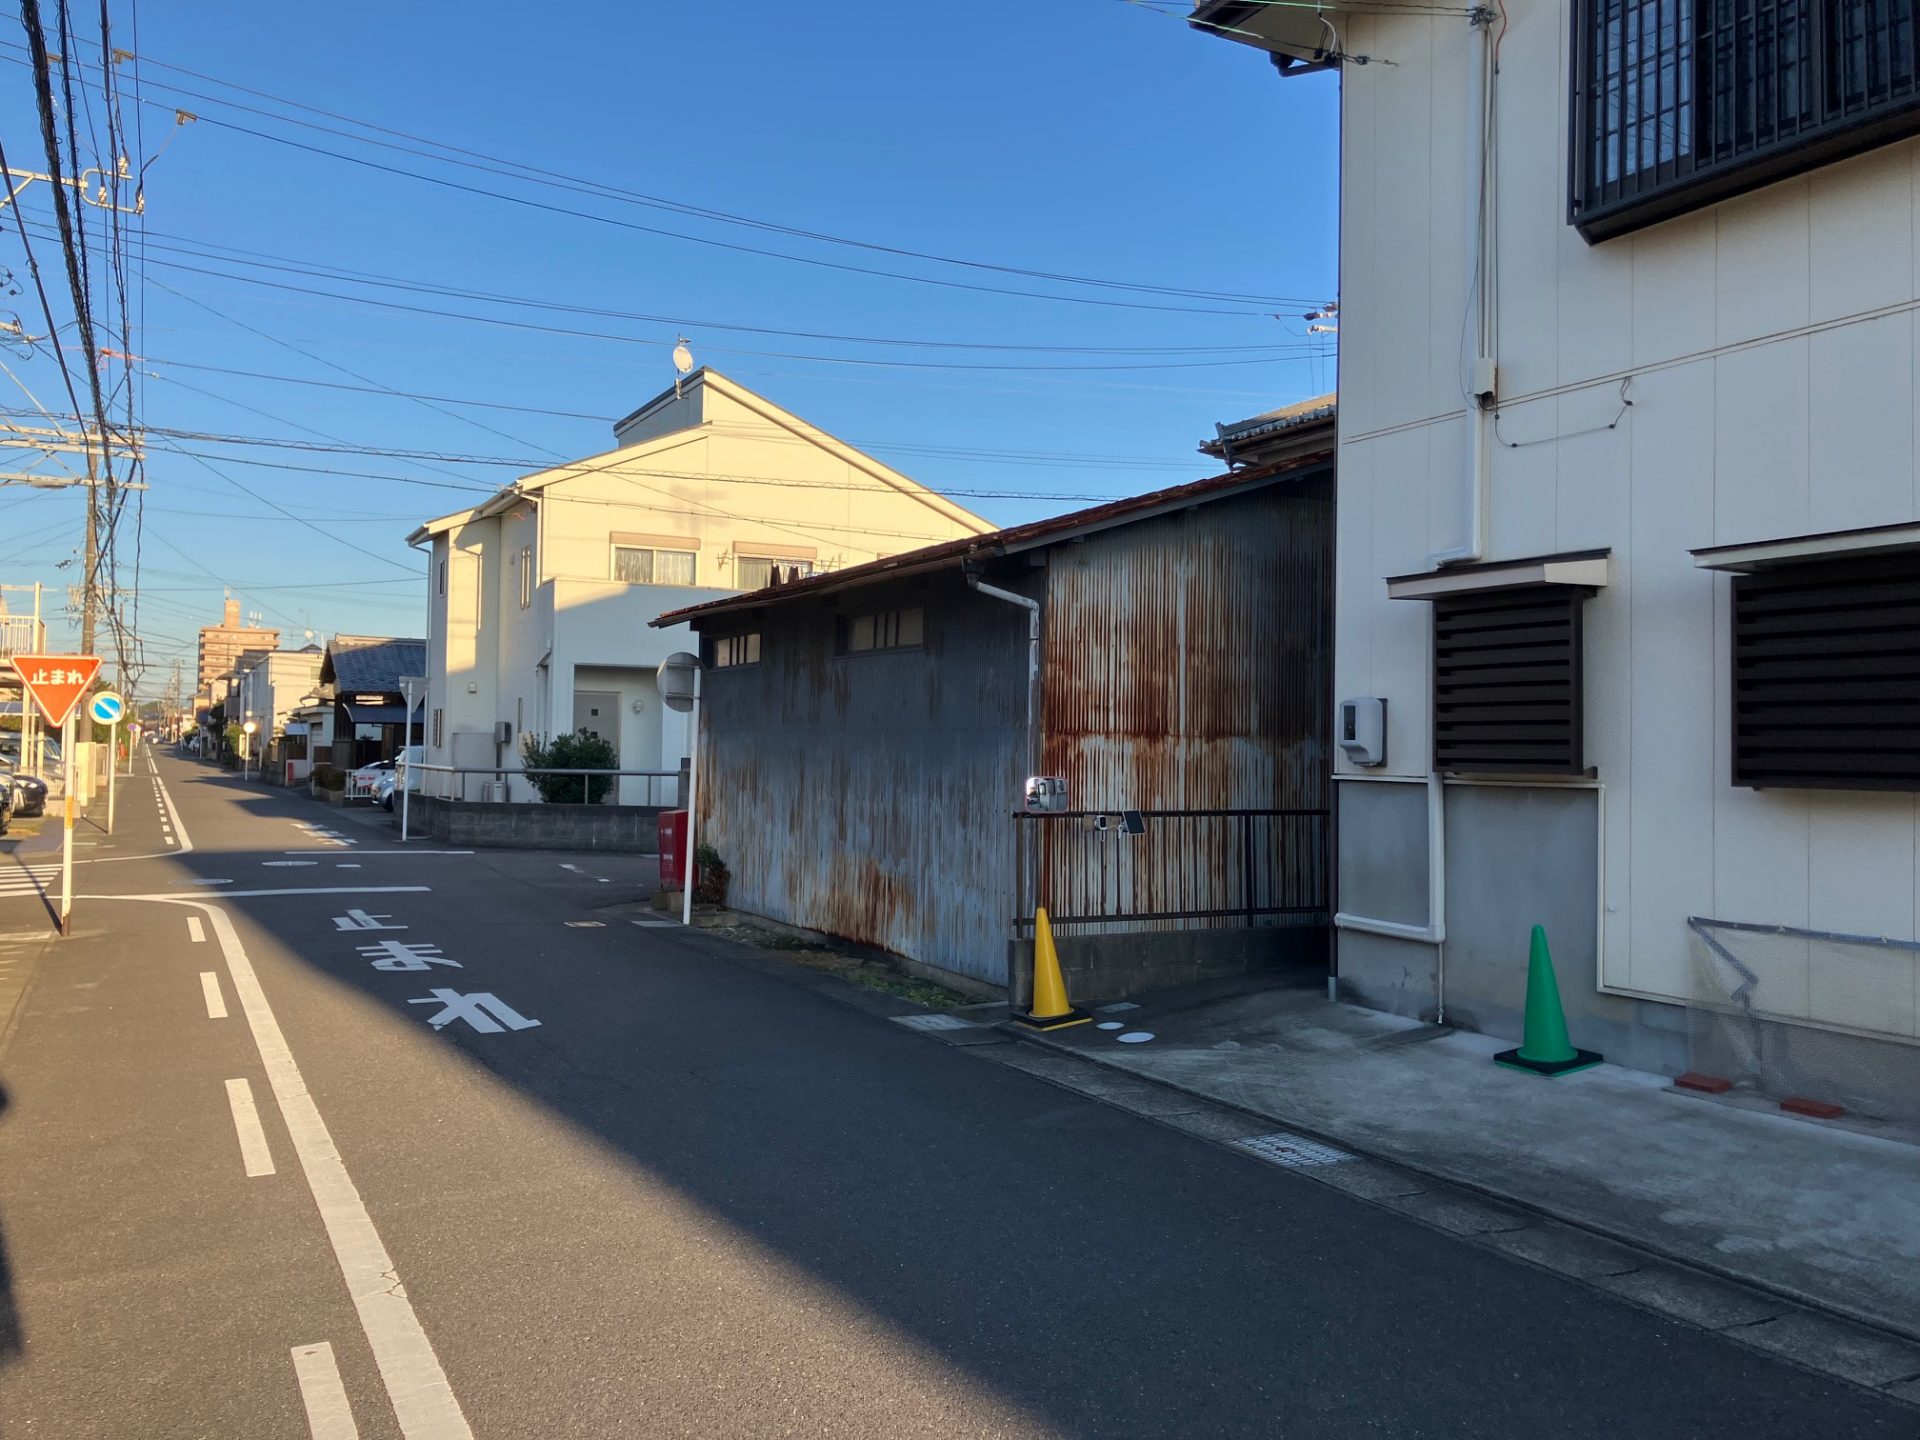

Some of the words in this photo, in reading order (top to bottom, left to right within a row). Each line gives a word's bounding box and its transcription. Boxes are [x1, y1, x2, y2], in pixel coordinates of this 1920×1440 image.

[30, 668, 85, 685] 止まれ
[331, 909, 543, 1034] 止まれ
